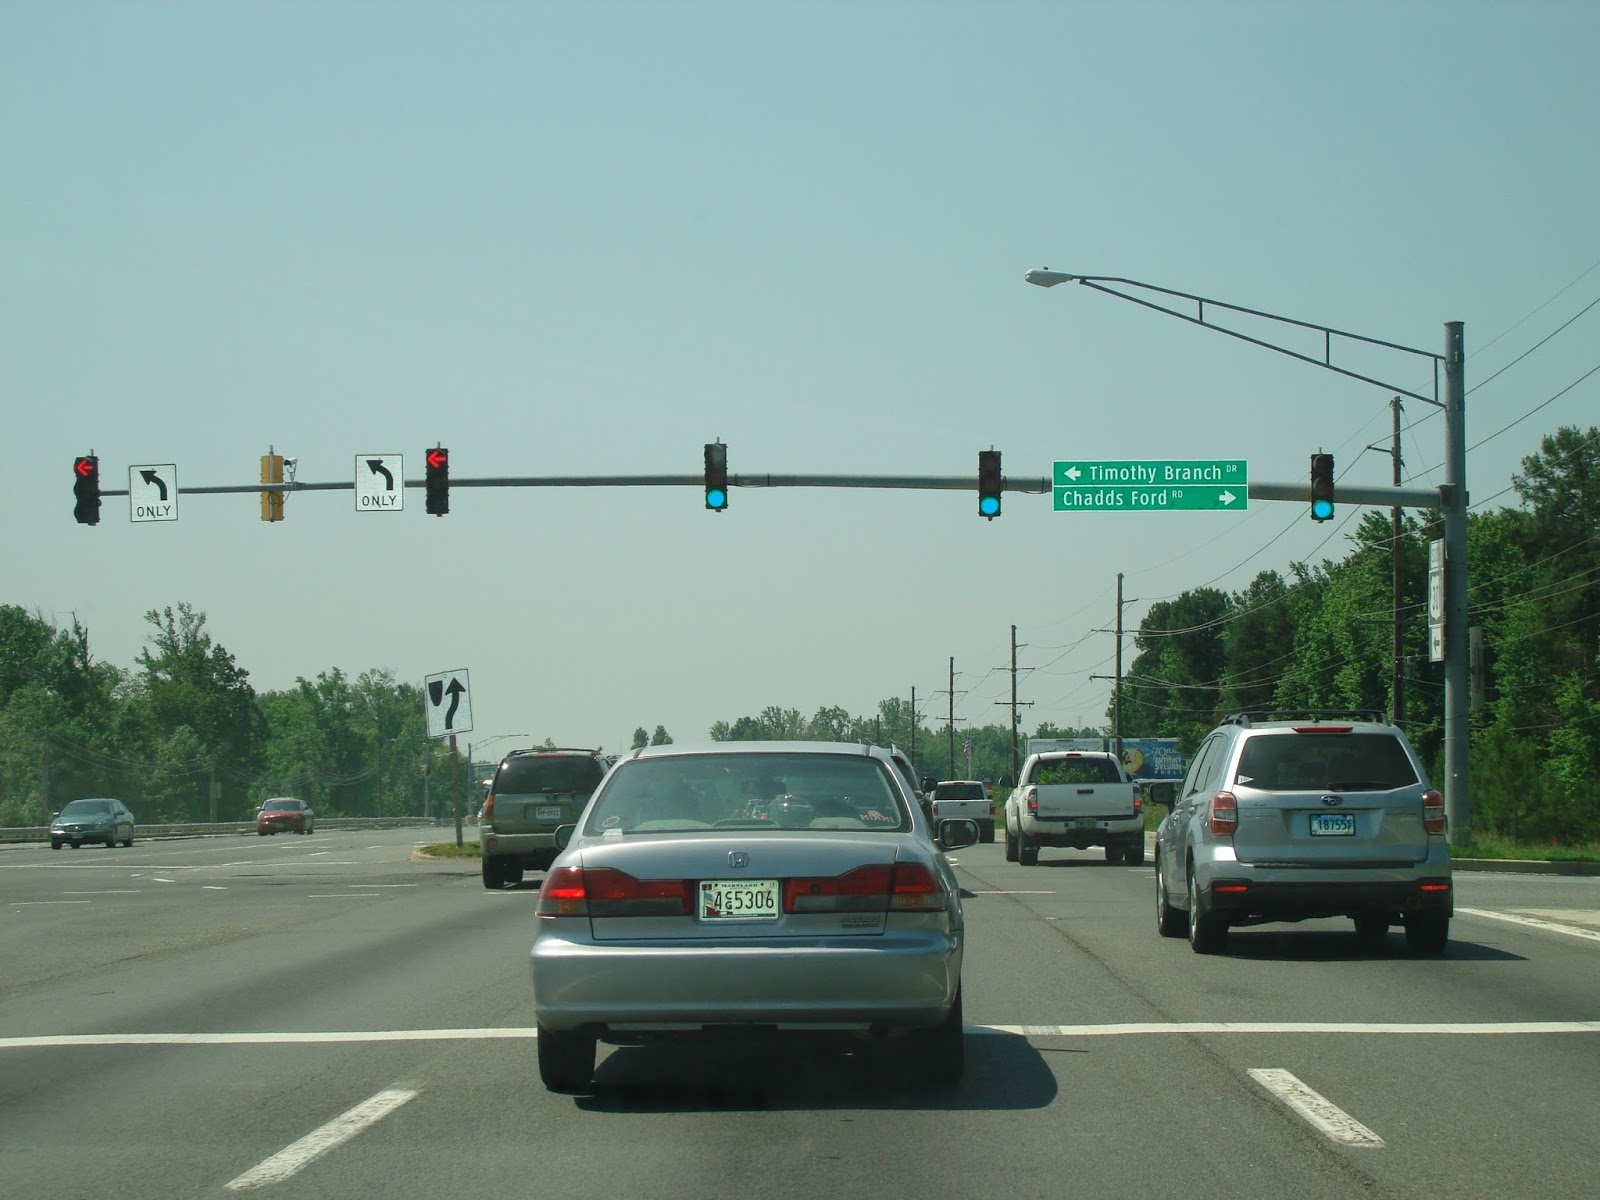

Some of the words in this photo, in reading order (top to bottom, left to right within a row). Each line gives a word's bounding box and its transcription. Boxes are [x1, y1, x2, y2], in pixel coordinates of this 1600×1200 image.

[1089, 465, 1157, 483] Timothy
[1164, 465, 1222, 480] Branch
[1226, 465, 1237, 473] DR
[362, 495, 397, 507] ONLY
[1063, 490, 1124, 506] Chadds
[1131, 490, 1168, 506] Ford
[1172, 490, 1183, 499] RD
[136, 505, 171, 518] ONLY
